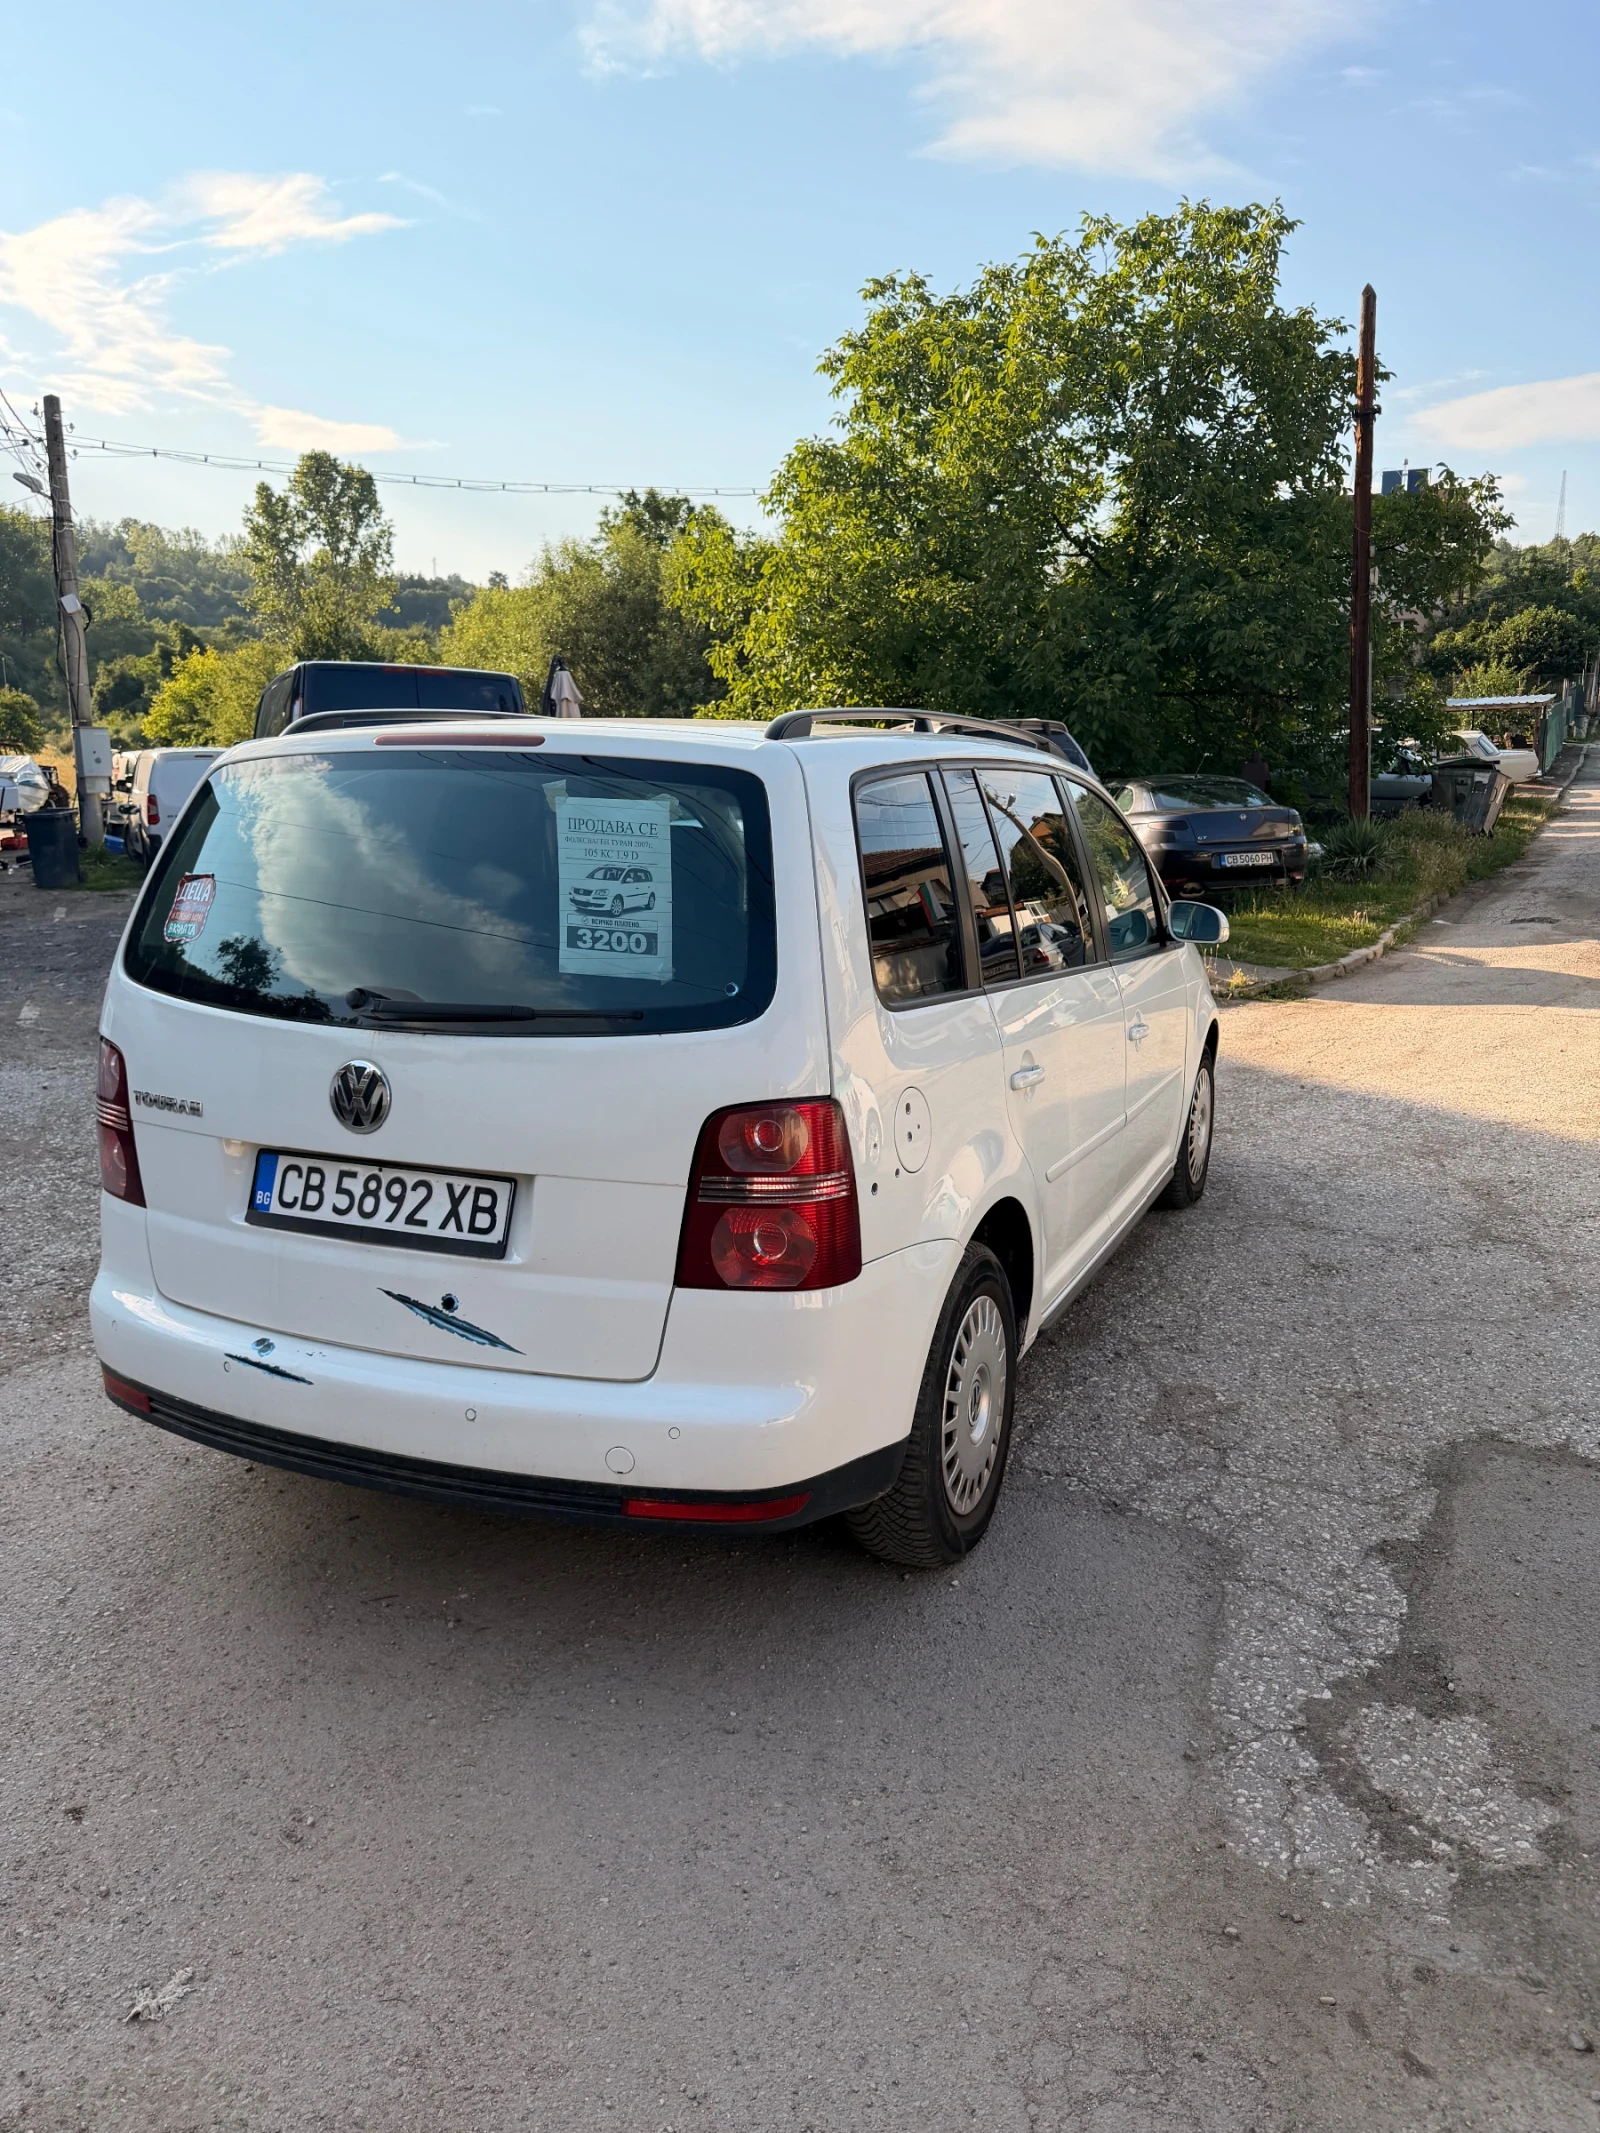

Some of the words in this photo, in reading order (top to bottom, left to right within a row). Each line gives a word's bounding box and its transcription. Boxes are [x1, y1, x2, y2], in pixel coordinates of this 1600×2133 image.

[568, 818, 634, 834] ПРОДАВА
[639, 822, 658, 836] СЕ
[564, 836, 610, 846] ФОЛКСВАГЕН
[611, 839, 633, 847] ТУРАН
[634, 841, 654, 849] 2007г.
[584, 848, 598, 858] 105
[600, 850, 614, 859] КС
[616, 850, 629, 860] 1.9
[631, 851, 639, 860] D
[1239, 854, 1261, 864] 5060
[177, 882, 212, 902] ДЕЦА
[591, 918, 614, 926] ВСИЧКО
[576, 928, 648, 954] 3200
[132, 1090, 204, 1118] TOURAN
[331, 1061, 391, 1133] VW
[255, 1190, 272, 1205] BG
[278, 1164, 326, 1212] CB
[331, 1170, 434, 1228] 5892
